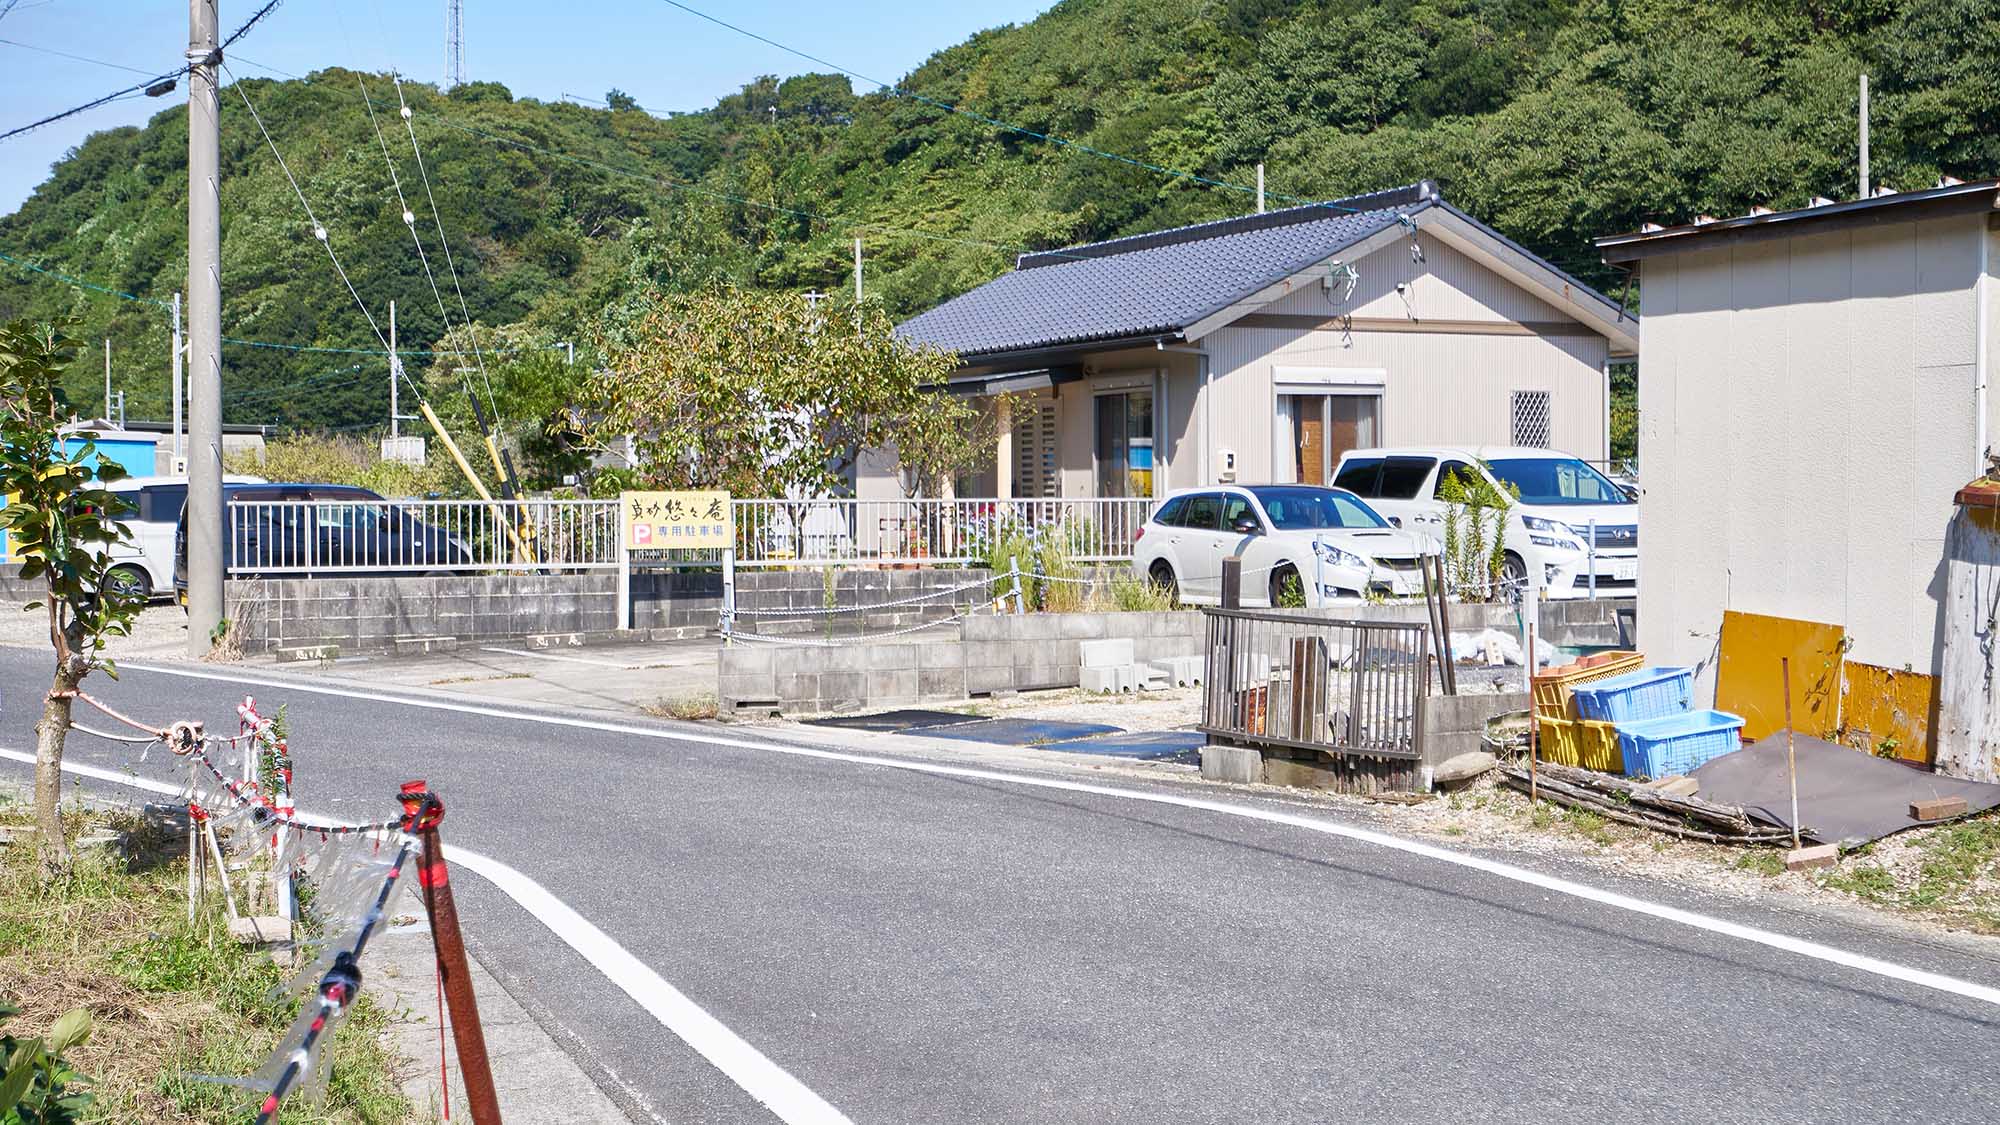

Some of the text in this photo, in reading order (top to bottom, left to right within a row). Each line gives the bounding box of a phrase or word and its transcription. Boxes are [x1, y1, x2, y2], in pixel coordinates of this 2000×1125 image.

[633, 525, 723, 544] P 専用駐車場
[677, 628, 684, 638] 2
